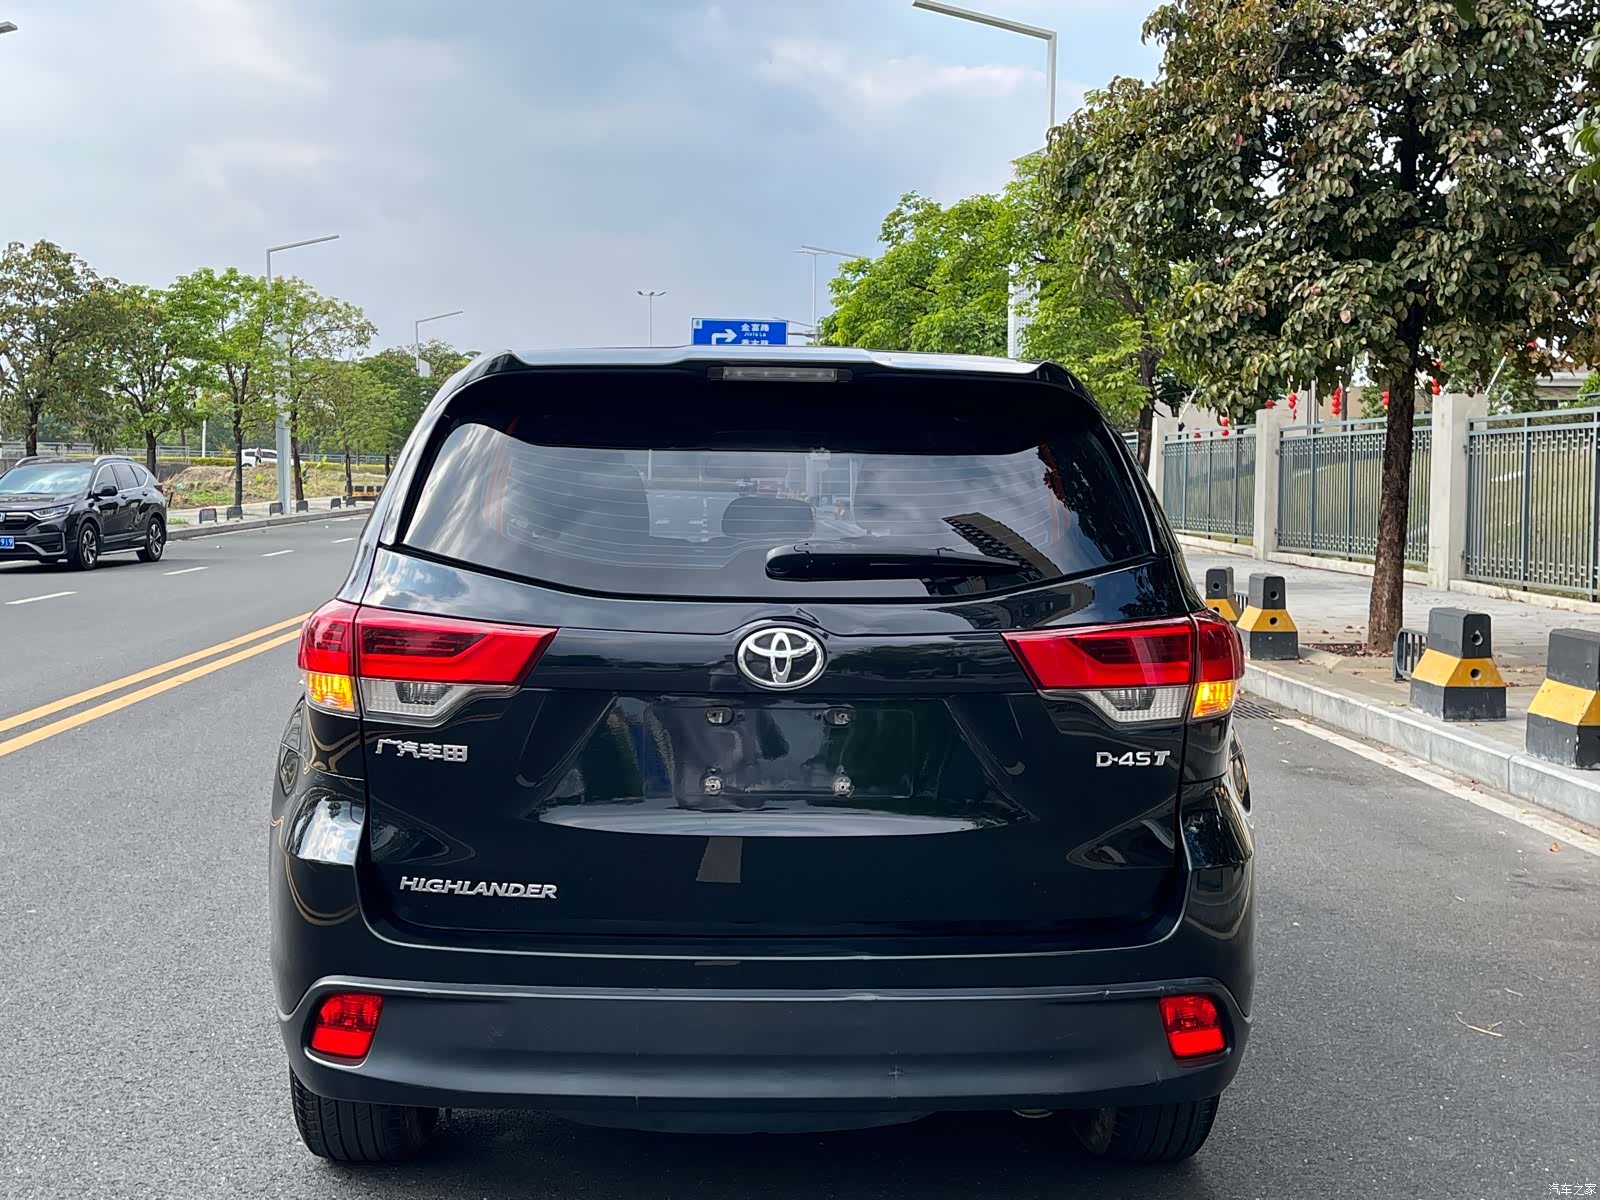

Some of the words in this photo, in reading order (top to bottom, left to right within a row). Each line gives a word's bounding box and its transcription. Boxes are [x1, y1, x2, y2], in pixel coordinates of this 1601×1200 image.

[740, 323, 770, 332] 金富路
[375, 739, 468, 762] 广汽丰田
[400, 876, 557, 899] HIGHLANDER
